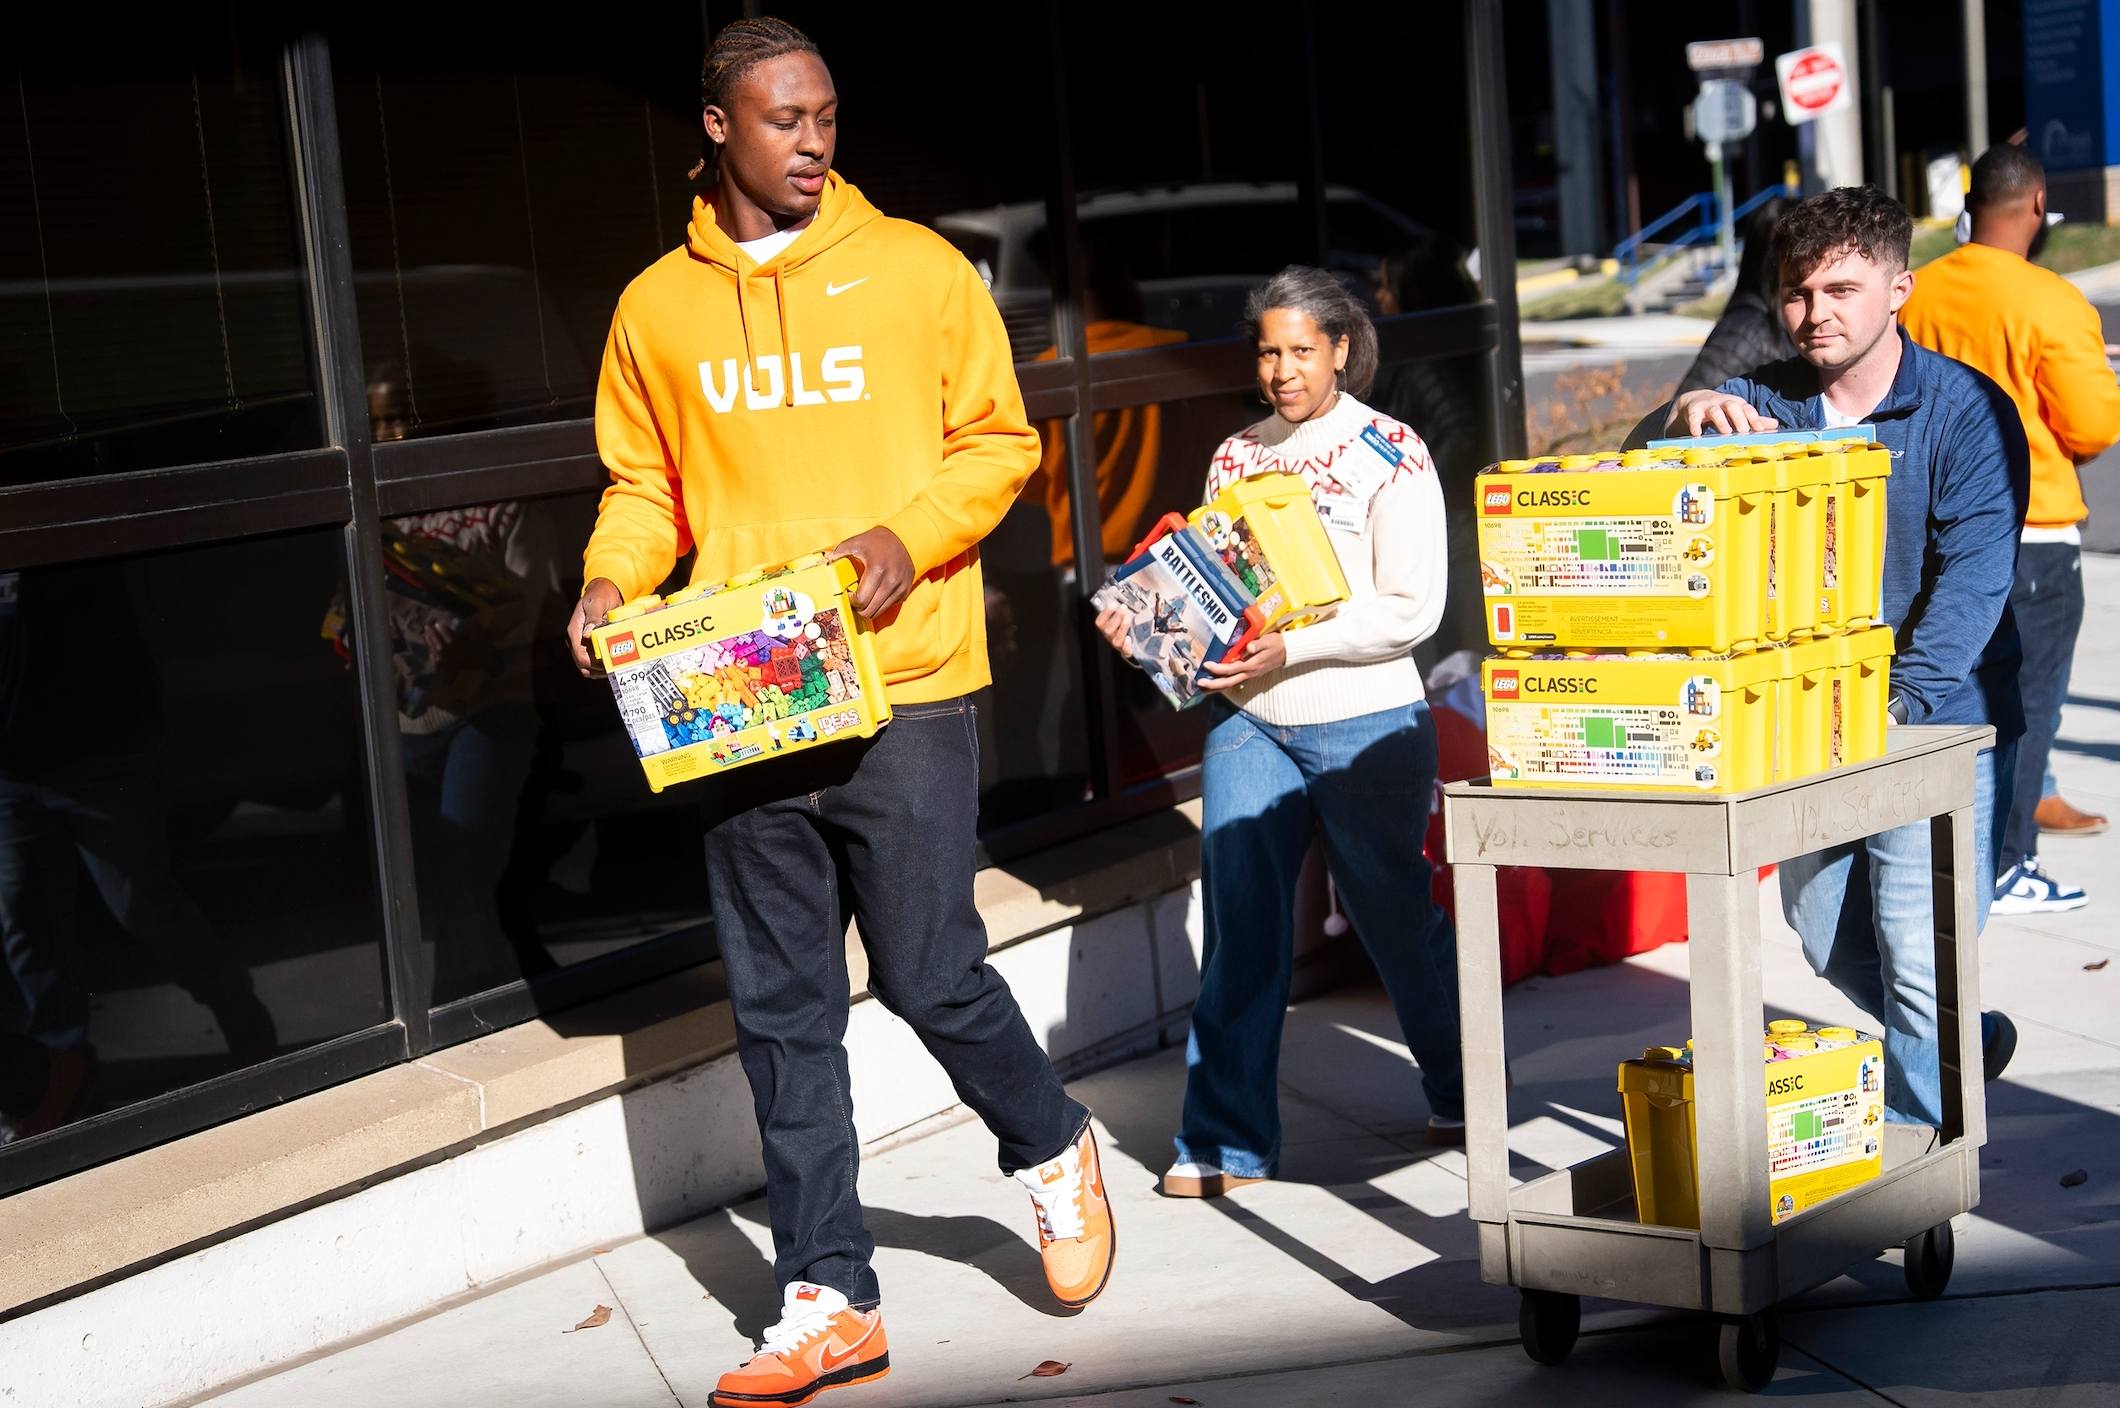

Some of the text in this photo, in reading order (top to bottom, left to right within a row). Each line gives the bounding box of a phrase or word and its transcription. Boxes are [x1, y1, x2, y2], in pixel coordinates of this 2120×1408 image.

[698, 345, 866, 414] VOLS
[1486, 490, 1590, 507] LEGO CLASSIC
[1160, 545, 1228, 626] BATTLESHIP
[1258, 591, 1282, 615] IDEAS
[611, 616, 715, 657] LEGO CLASSIC
[619, 672, 647, 686] 4-99
[622, 686, 640, 694] 10698
[1493, 676, 1598, 694] LEGO CLASSIC
[629, 706, 647, 717] 790
[817, 708, 859, 730] IDEAS
[1548, 814, 1680, 848] Services
[1765, 1074, 1804, 1096] ASSIC
